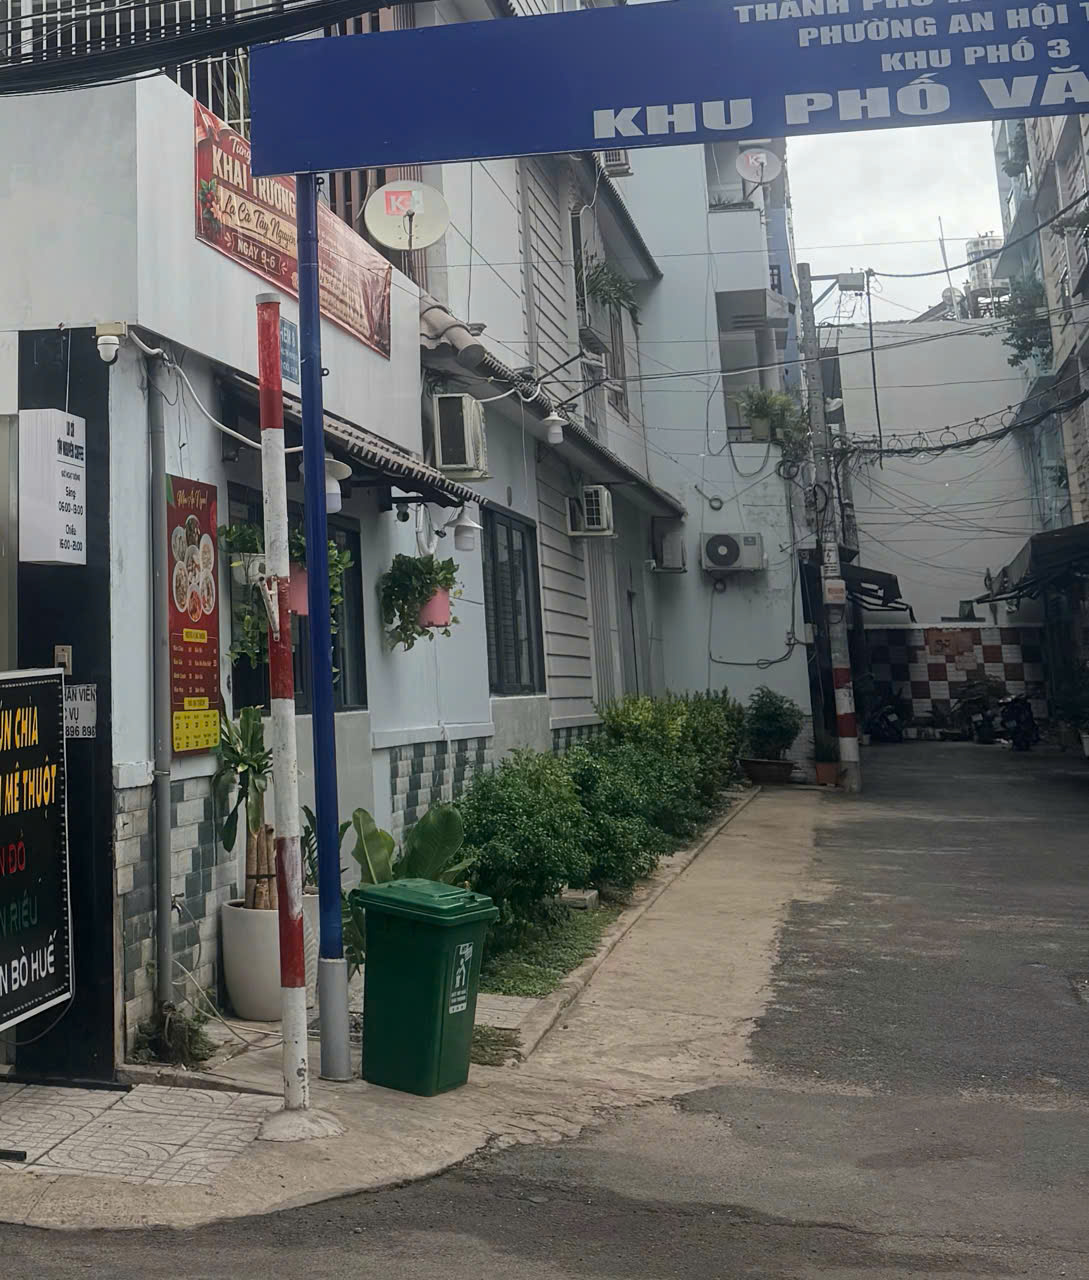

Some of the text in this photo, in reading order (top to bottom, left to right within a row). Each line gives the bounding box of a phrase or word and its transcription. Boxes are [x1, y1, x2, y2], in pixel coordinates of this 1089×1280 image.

[799, 17, 938, 47] PHƯỜNG
[948, 11, 995, 34] AN
[1006, 2, 1069, 29] HỘI
[882, 36, 1071, 73] KHU PHỐ 3
[593, 98, 753, 140] KHU
[785, 73, 951, 126] PHỐ
[213, 144, 248, 192] KHAI
[4, 761, 20, 817] MÊ
[23, 755, 57, 819] THUỘT
[11, 946, 29, 991] BÒ
[31, 929, 58, 982] HUẾ
